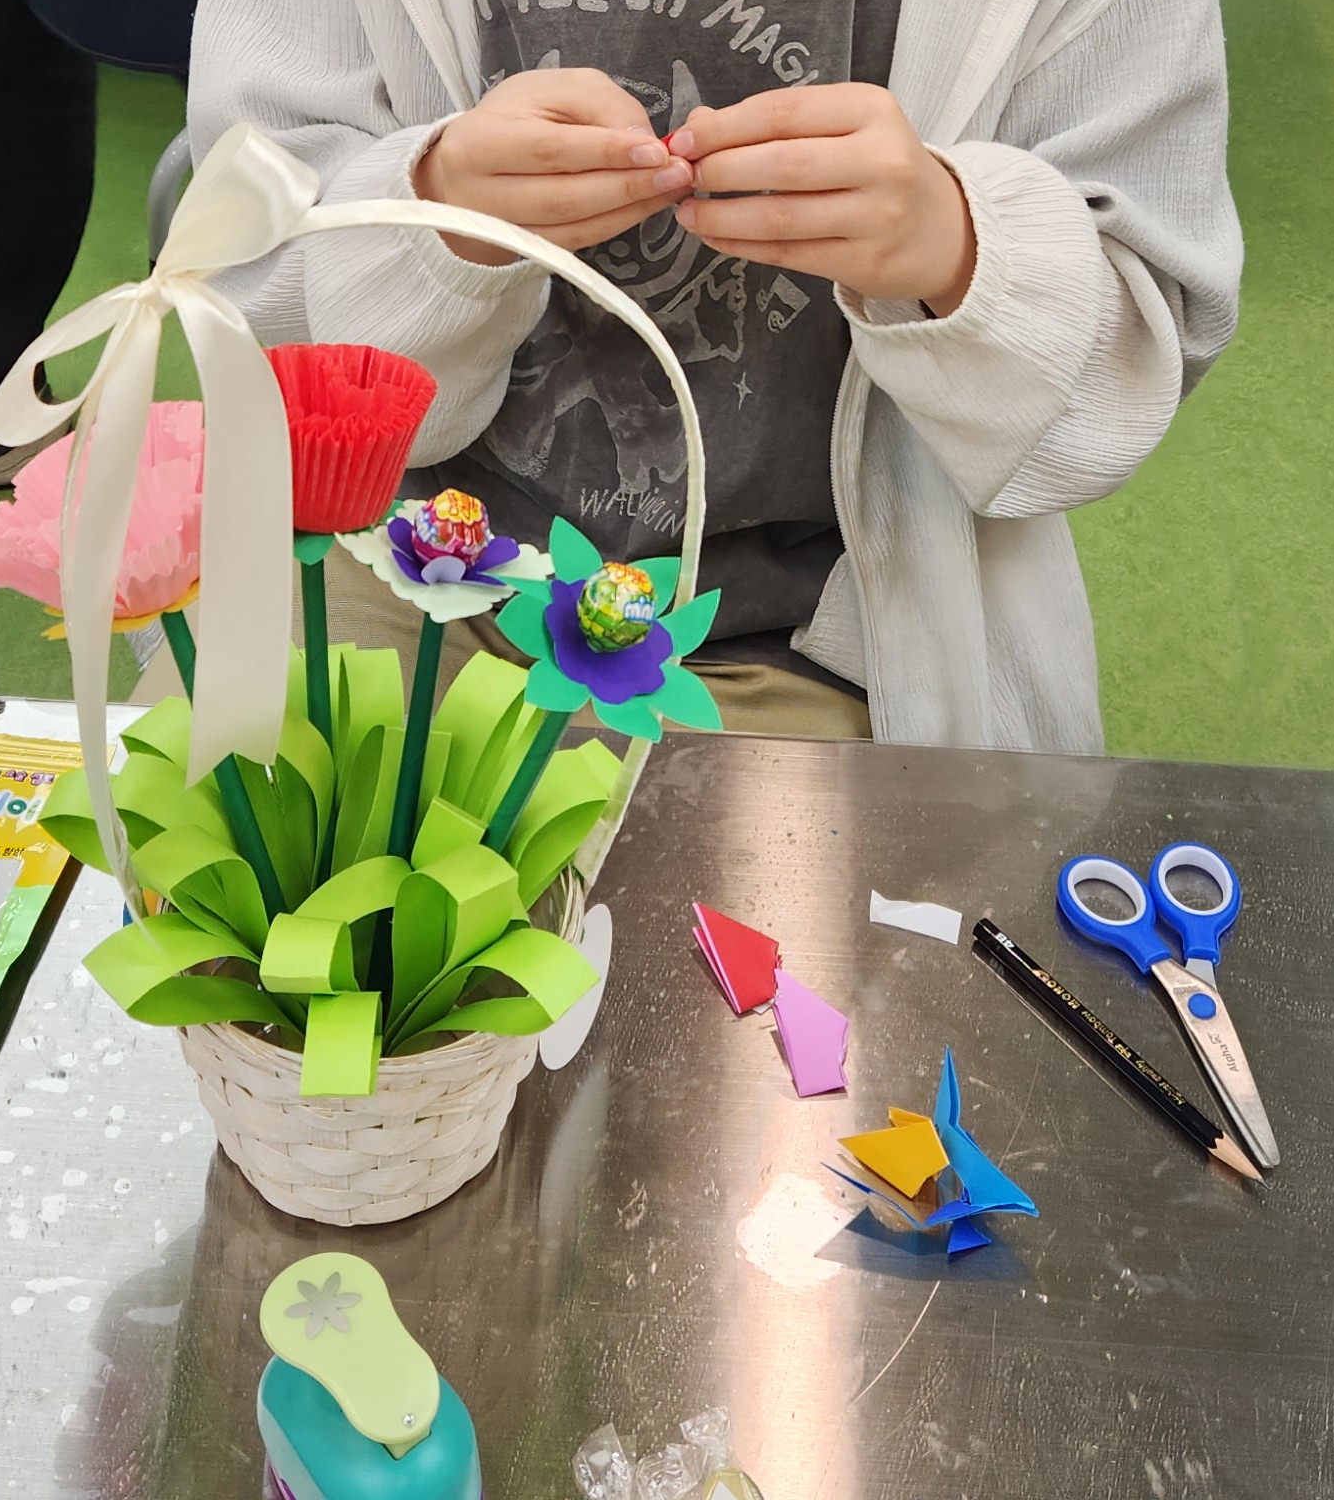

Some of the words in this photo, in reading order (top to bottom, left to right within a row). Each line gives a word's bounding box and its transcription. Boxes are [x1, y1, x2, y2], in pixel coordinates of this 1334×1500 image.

[994, 932, 1015, 949] 4B
[1081, 1010, 1116, 1045] Tombow
[1220, 1044, 1239, 1072] Alpha
